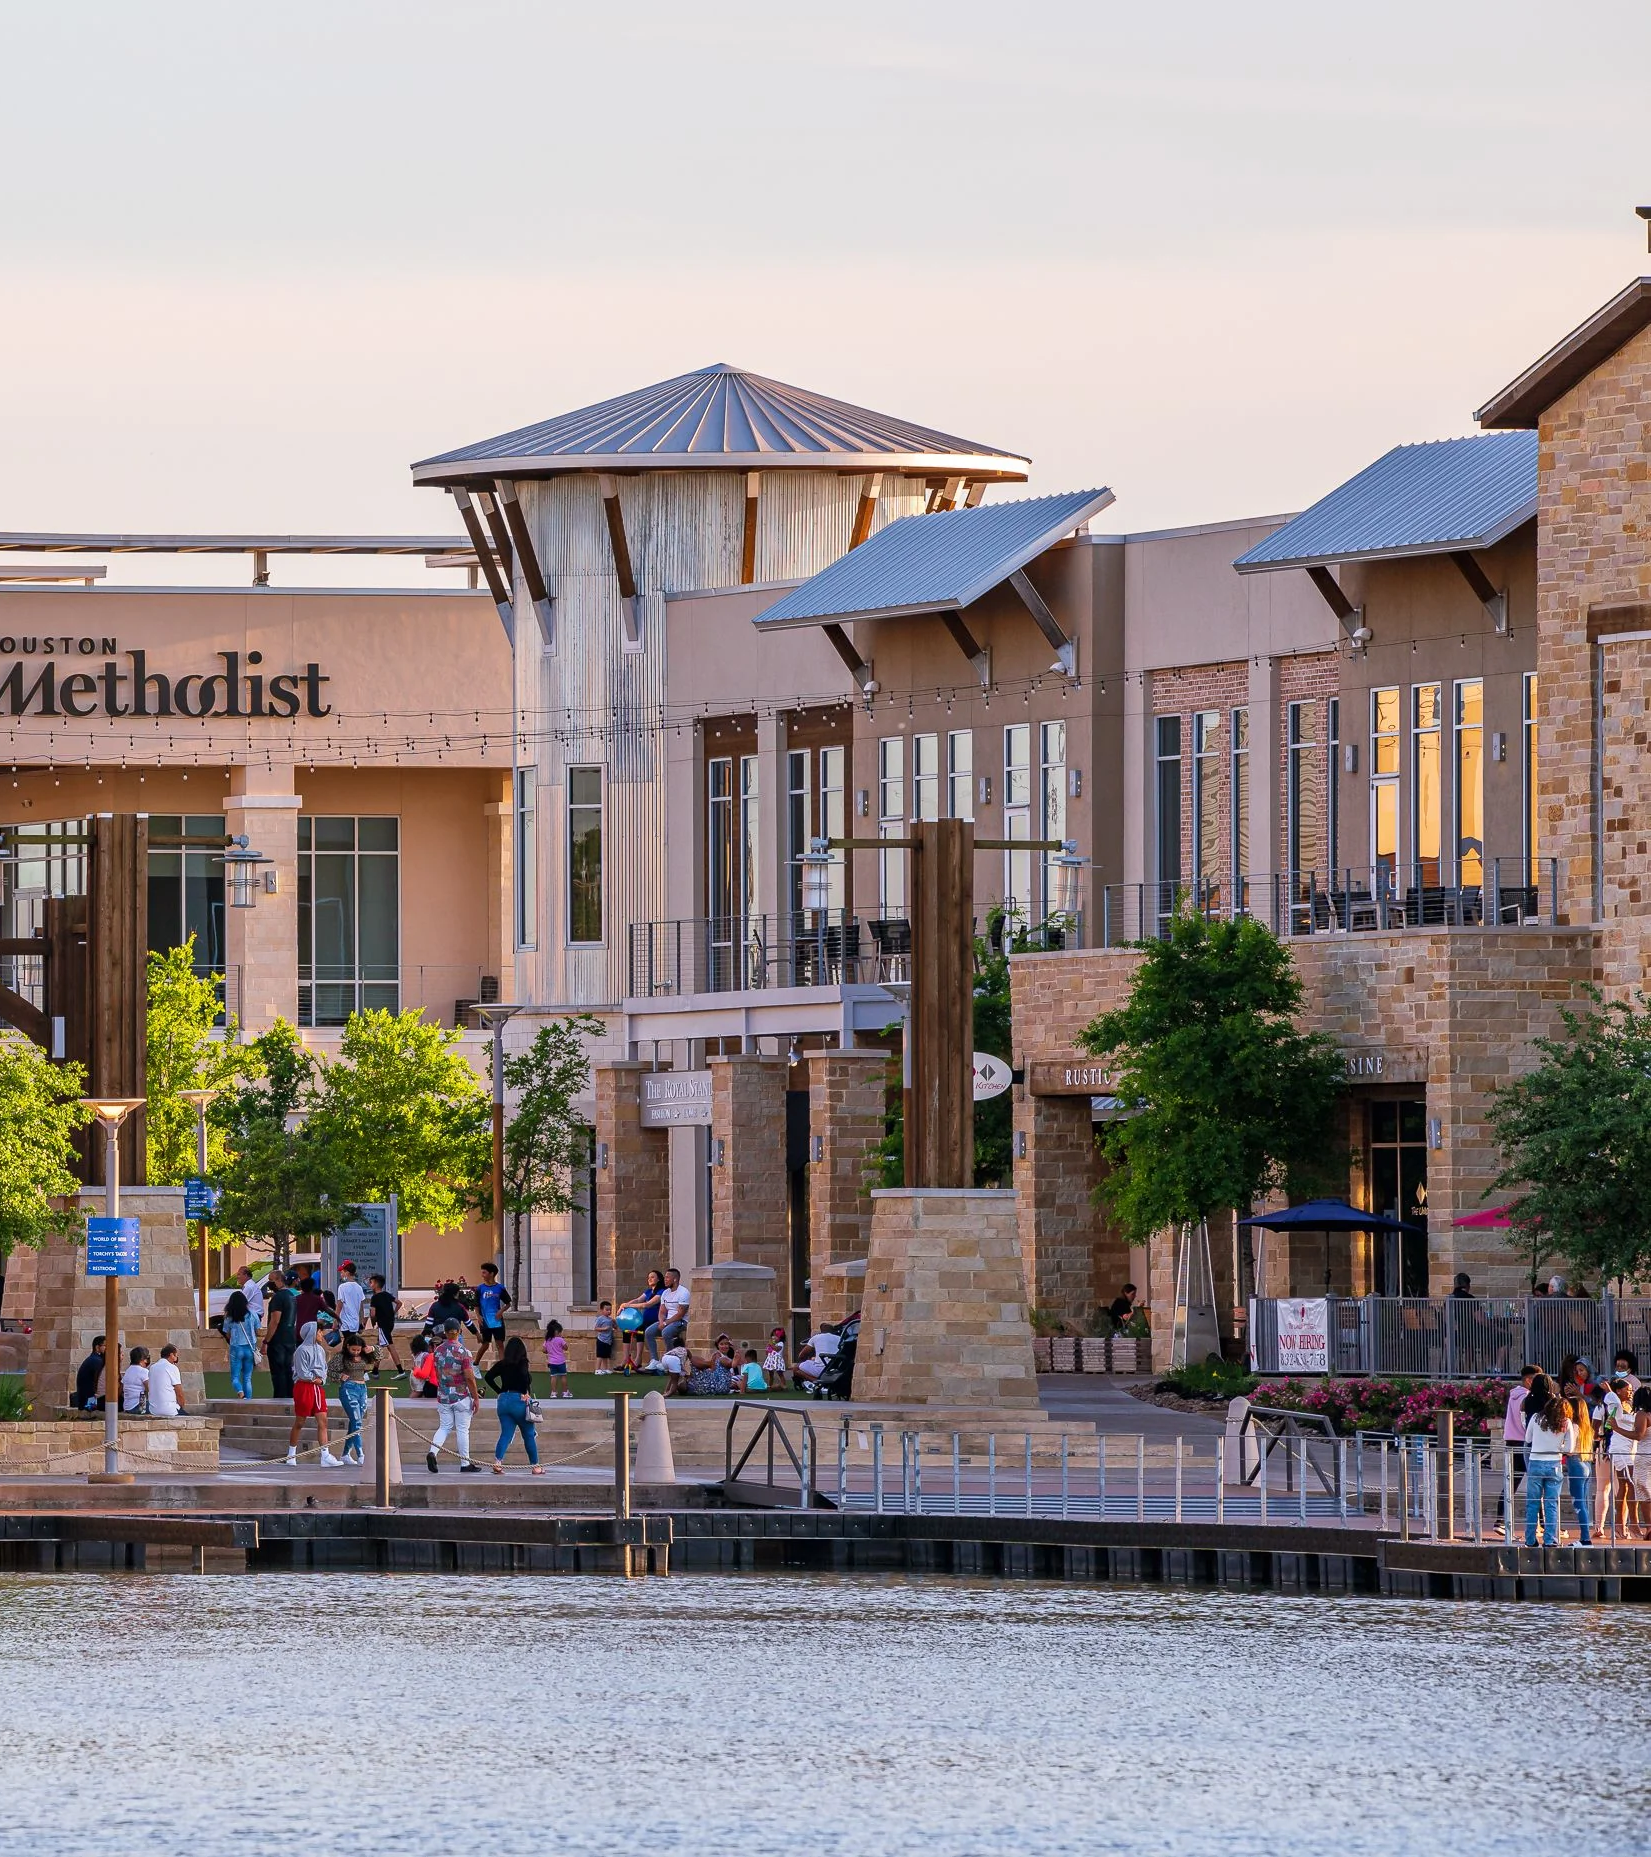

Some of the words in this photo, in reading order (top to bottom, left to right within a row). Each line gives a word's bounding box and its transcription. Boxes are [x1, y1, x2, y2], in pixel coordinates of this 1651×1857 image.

[645, 1079, 661, 1100] THE
[664, 1079, 689, 1099] ROYAL
[975, 1081, 1007, 1090] KITCHEN
[1279, 1334, 1297, 1350] NOW
[1299, 1334, 1326, 1350] HIRING
